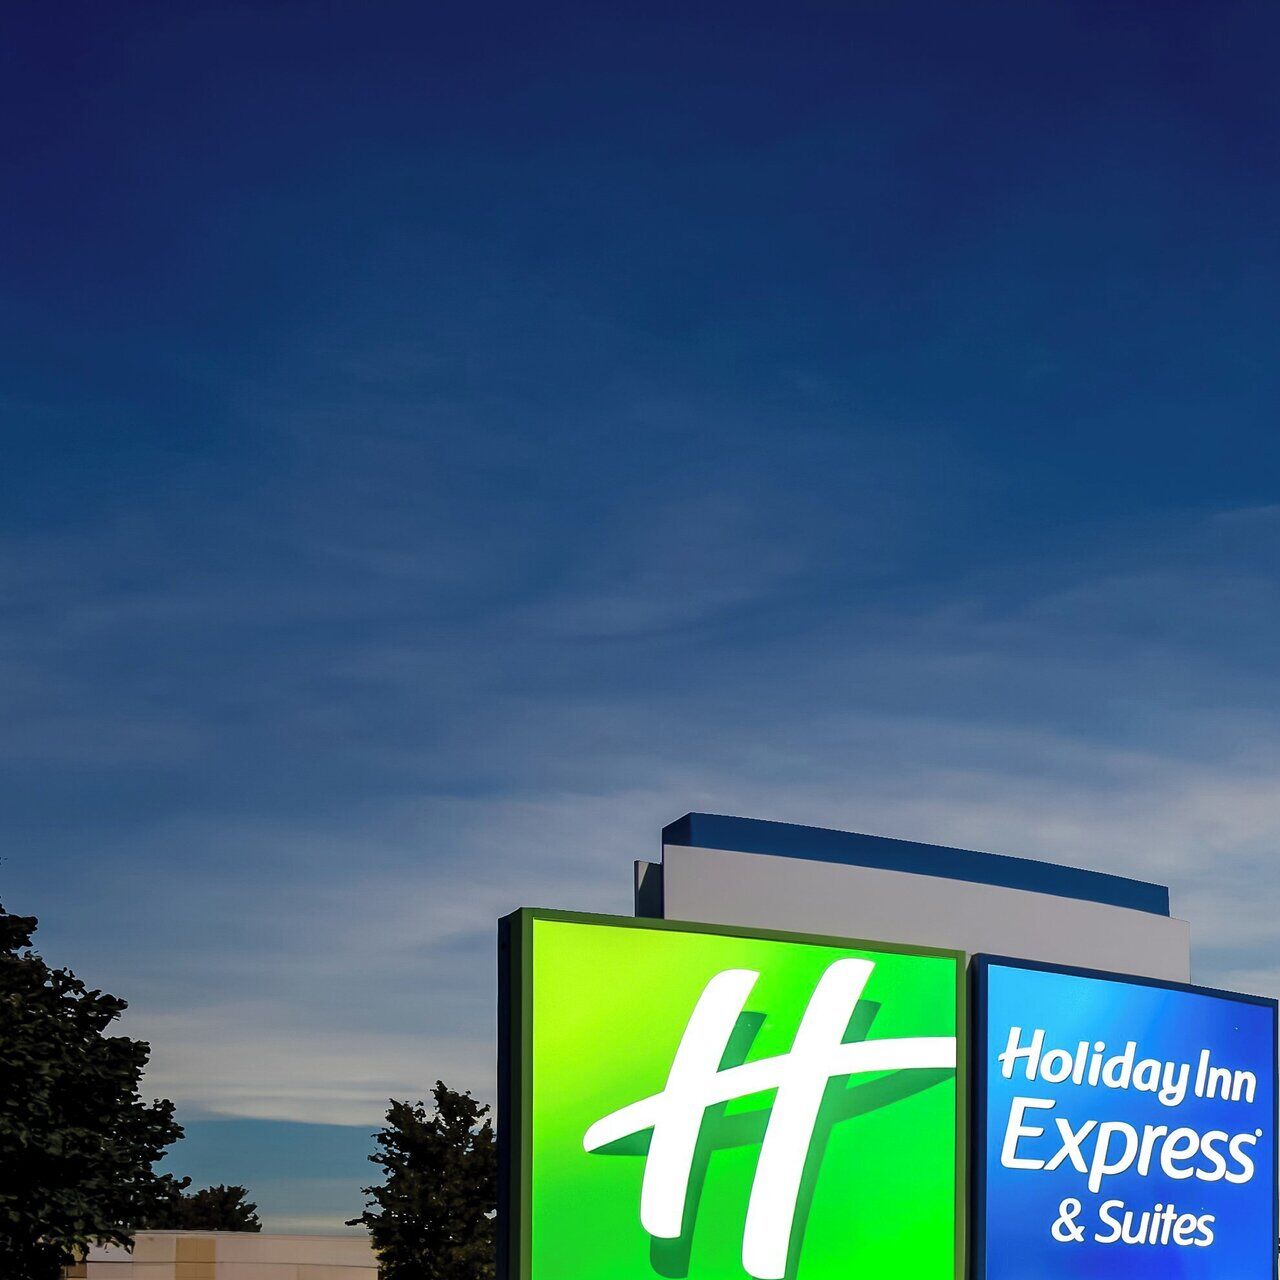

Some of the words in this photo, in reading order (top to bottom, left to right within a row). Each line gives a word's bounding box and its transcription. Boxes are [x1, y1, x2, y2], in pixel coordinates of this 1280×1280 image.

[998, 1026, 1190, 1107] Holiday
[1195, 1049, 1257, 1104] Inn
[1001, 1097, 1258, 1194] Express
[1051, 1197, 1085, 1242] &
[1094, 1199, 1215, 1247] Suites
